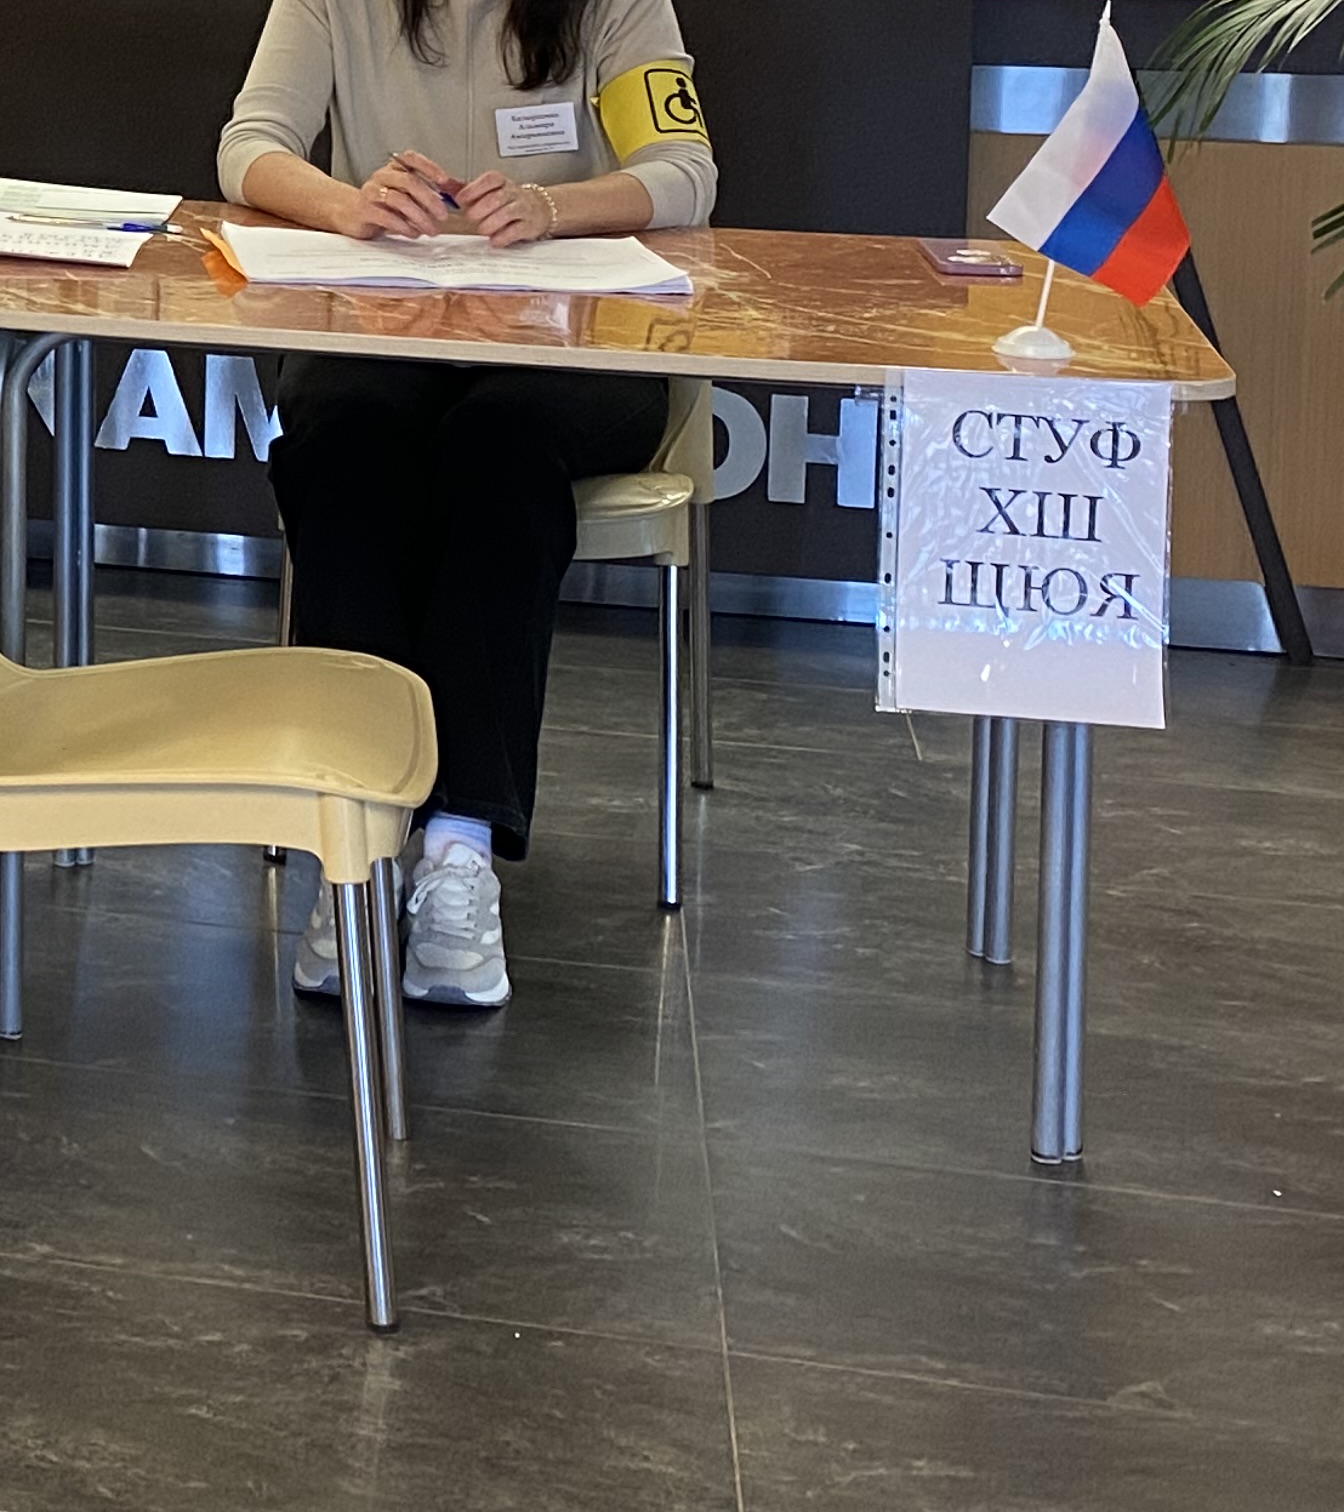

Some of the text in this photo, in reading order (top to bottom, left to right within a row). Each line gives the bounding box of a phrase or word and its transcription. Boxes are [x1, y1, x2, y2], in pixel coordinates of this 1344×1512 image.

[952, 409, 1142, 470] СТУФ
[976, 486, 1104, 543] ХШ
[938, 558, 1141, 621] ЩЮЯ
